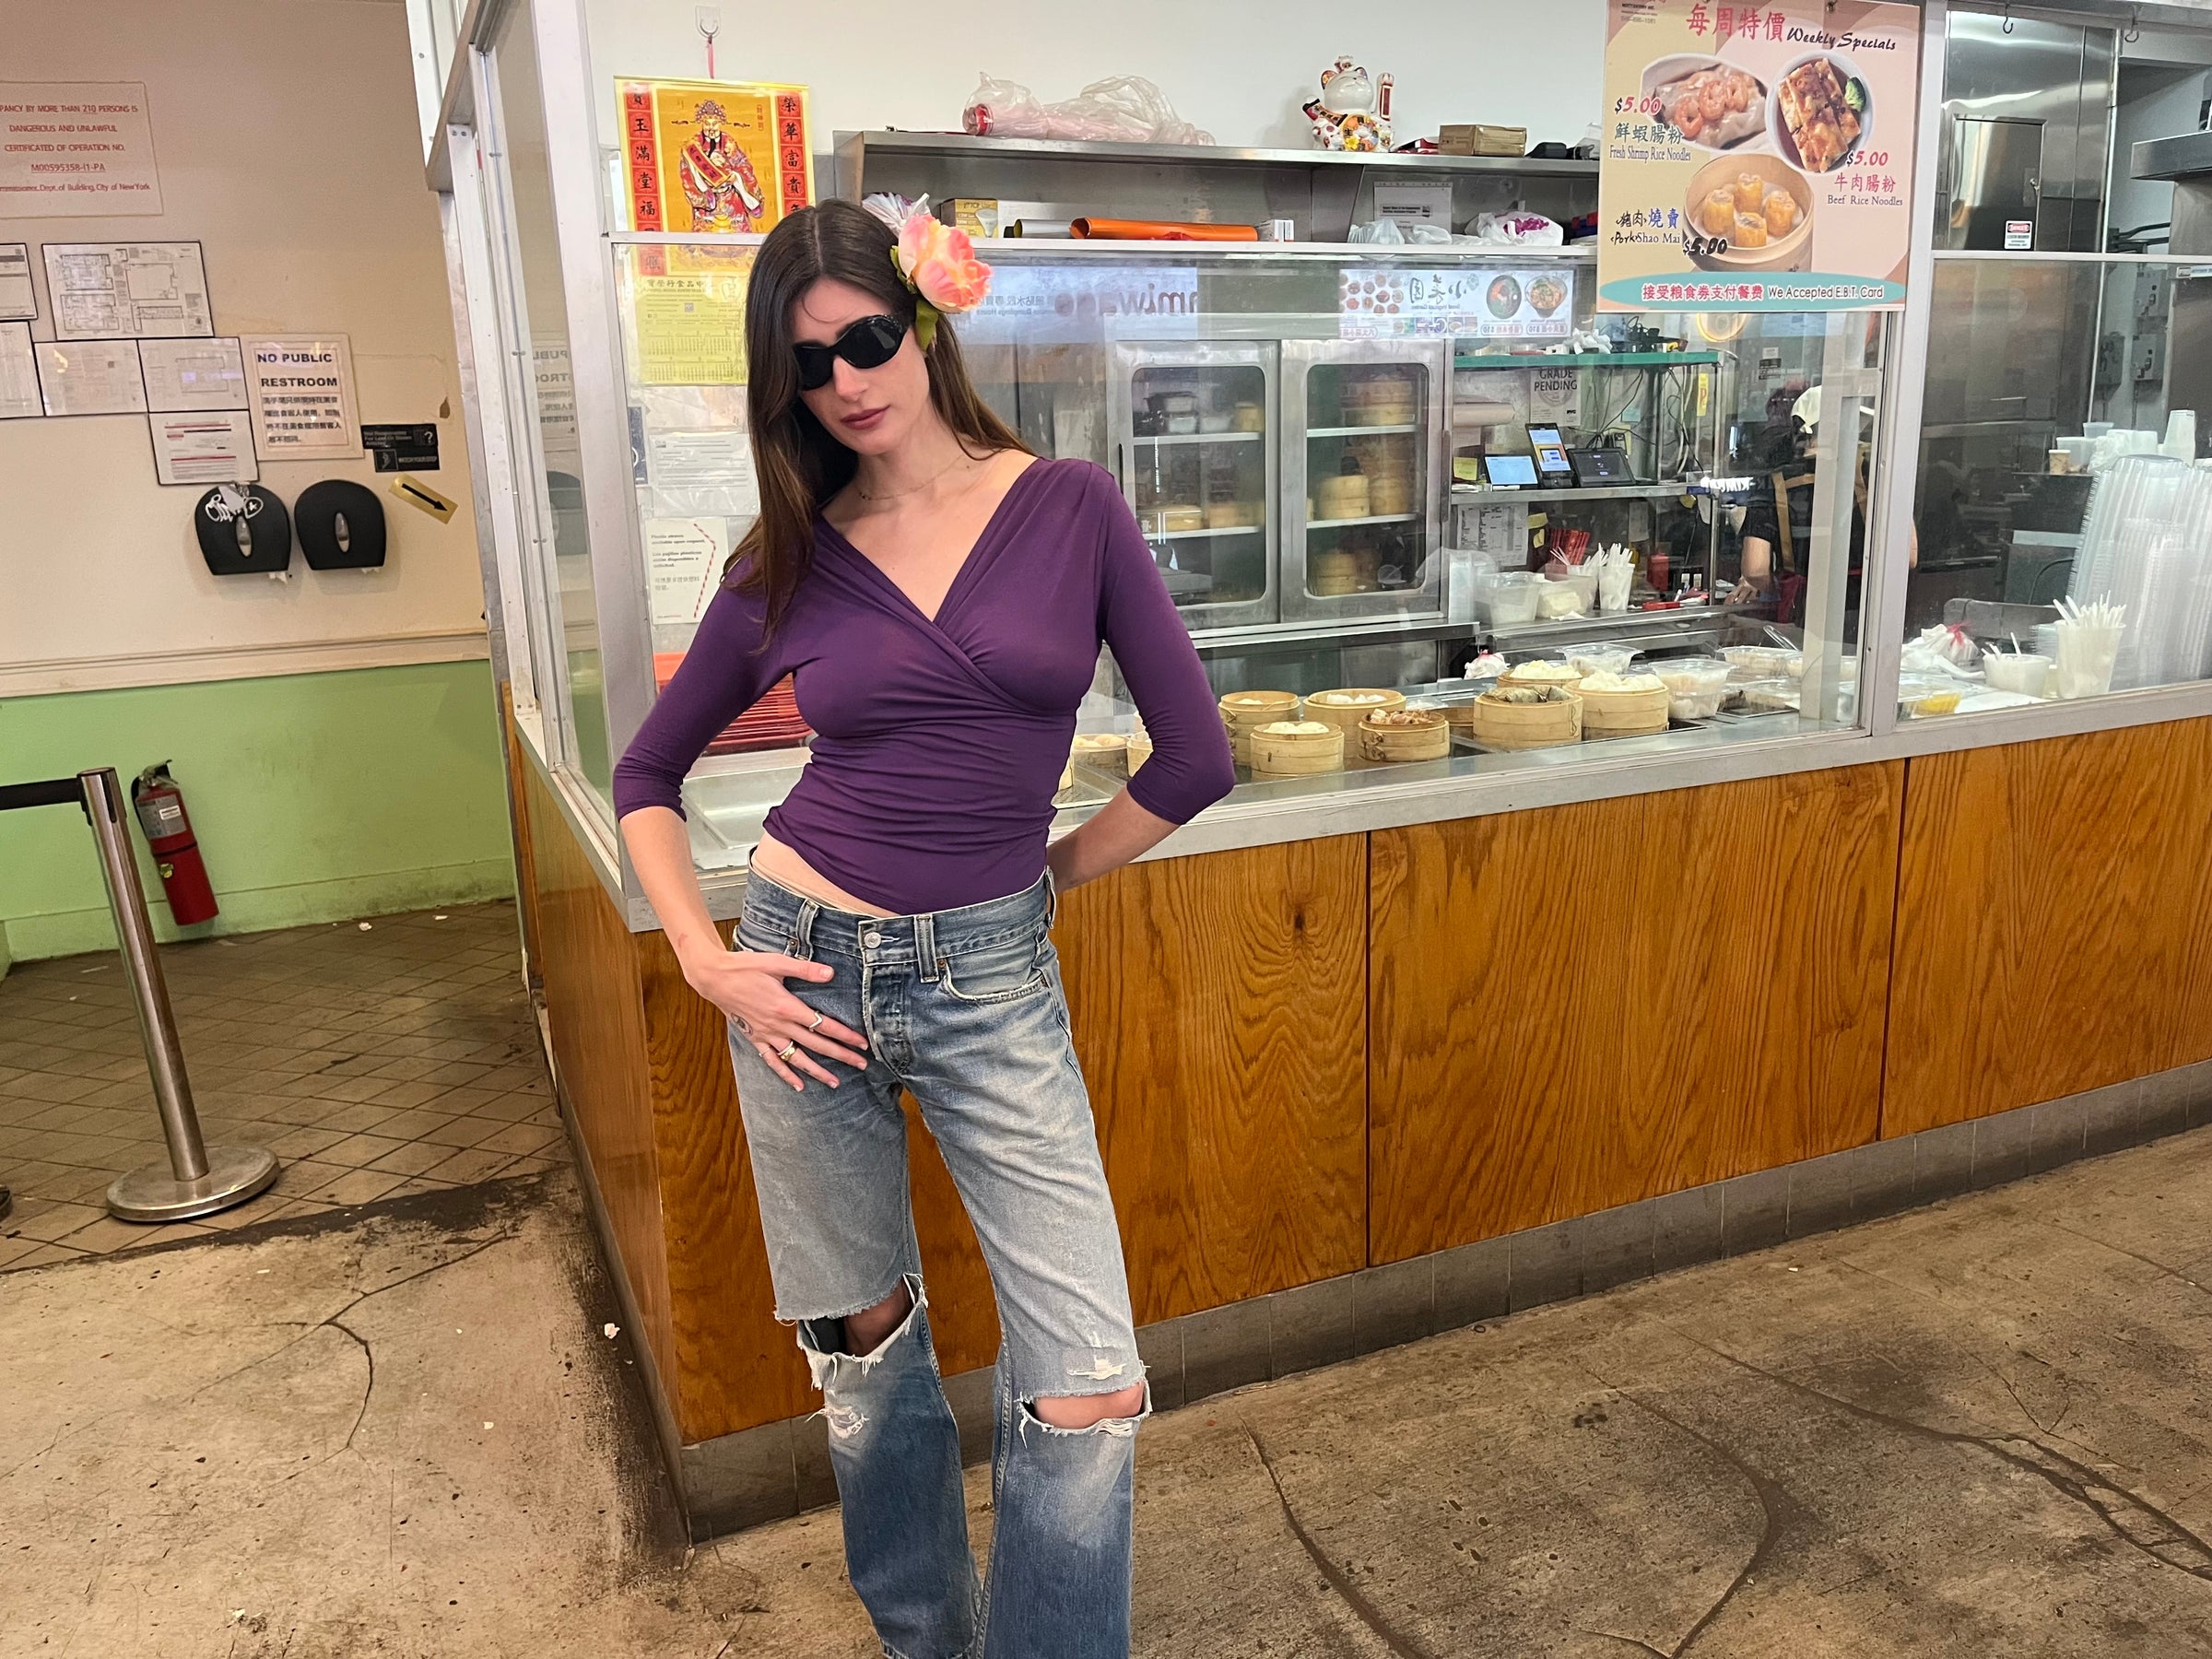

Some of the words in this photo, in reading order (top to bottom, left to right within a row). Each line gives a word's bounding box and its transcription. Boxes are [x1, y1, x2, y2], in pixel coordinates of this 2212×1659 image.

[1686, 3, 1785, 42] 每周特價
[1786, 27, 1837, 50] Weekly
[1837, 32, 1896, 52] Specials
[83, 104, 97, 112] 210
[1614, 96, 1662, 114] $5.00
[1614, 123, 1683, 145] 鮮蝦腸粉
[1610, 145, 1626, 159] Fresh
[1628, 146, 1649, 163] Shrimp
[1651, 147, 1665, 160] Rice
[1666, 147, 1691, 161] Noodles
[1846, 150, 1888, 167] $5.00
[1834, 172, 1896, 193] 牛肉腸粉
[1828, 194, 1846, 205] Beef
[1851, 195, 1869, 205] Rice
[1872, 196, 1903, 206] Noodles
[1637, 232, 1659, 244] Shao
[1663, 233, 1681, 244] Mai
[1768, 287, 1783, 298] We
[1786, 286, 1833, 300] Accepted
[1861, 287, 1884, 298] Card
[257, 353, 277, 363] NO
[282, 353, 333, 362] PUBLIC
[1539, 369, 1573, 380] GRADE
[261, 378, 337, 387] RESTROOM
[1534, 380, 1578, 392] PENDING
